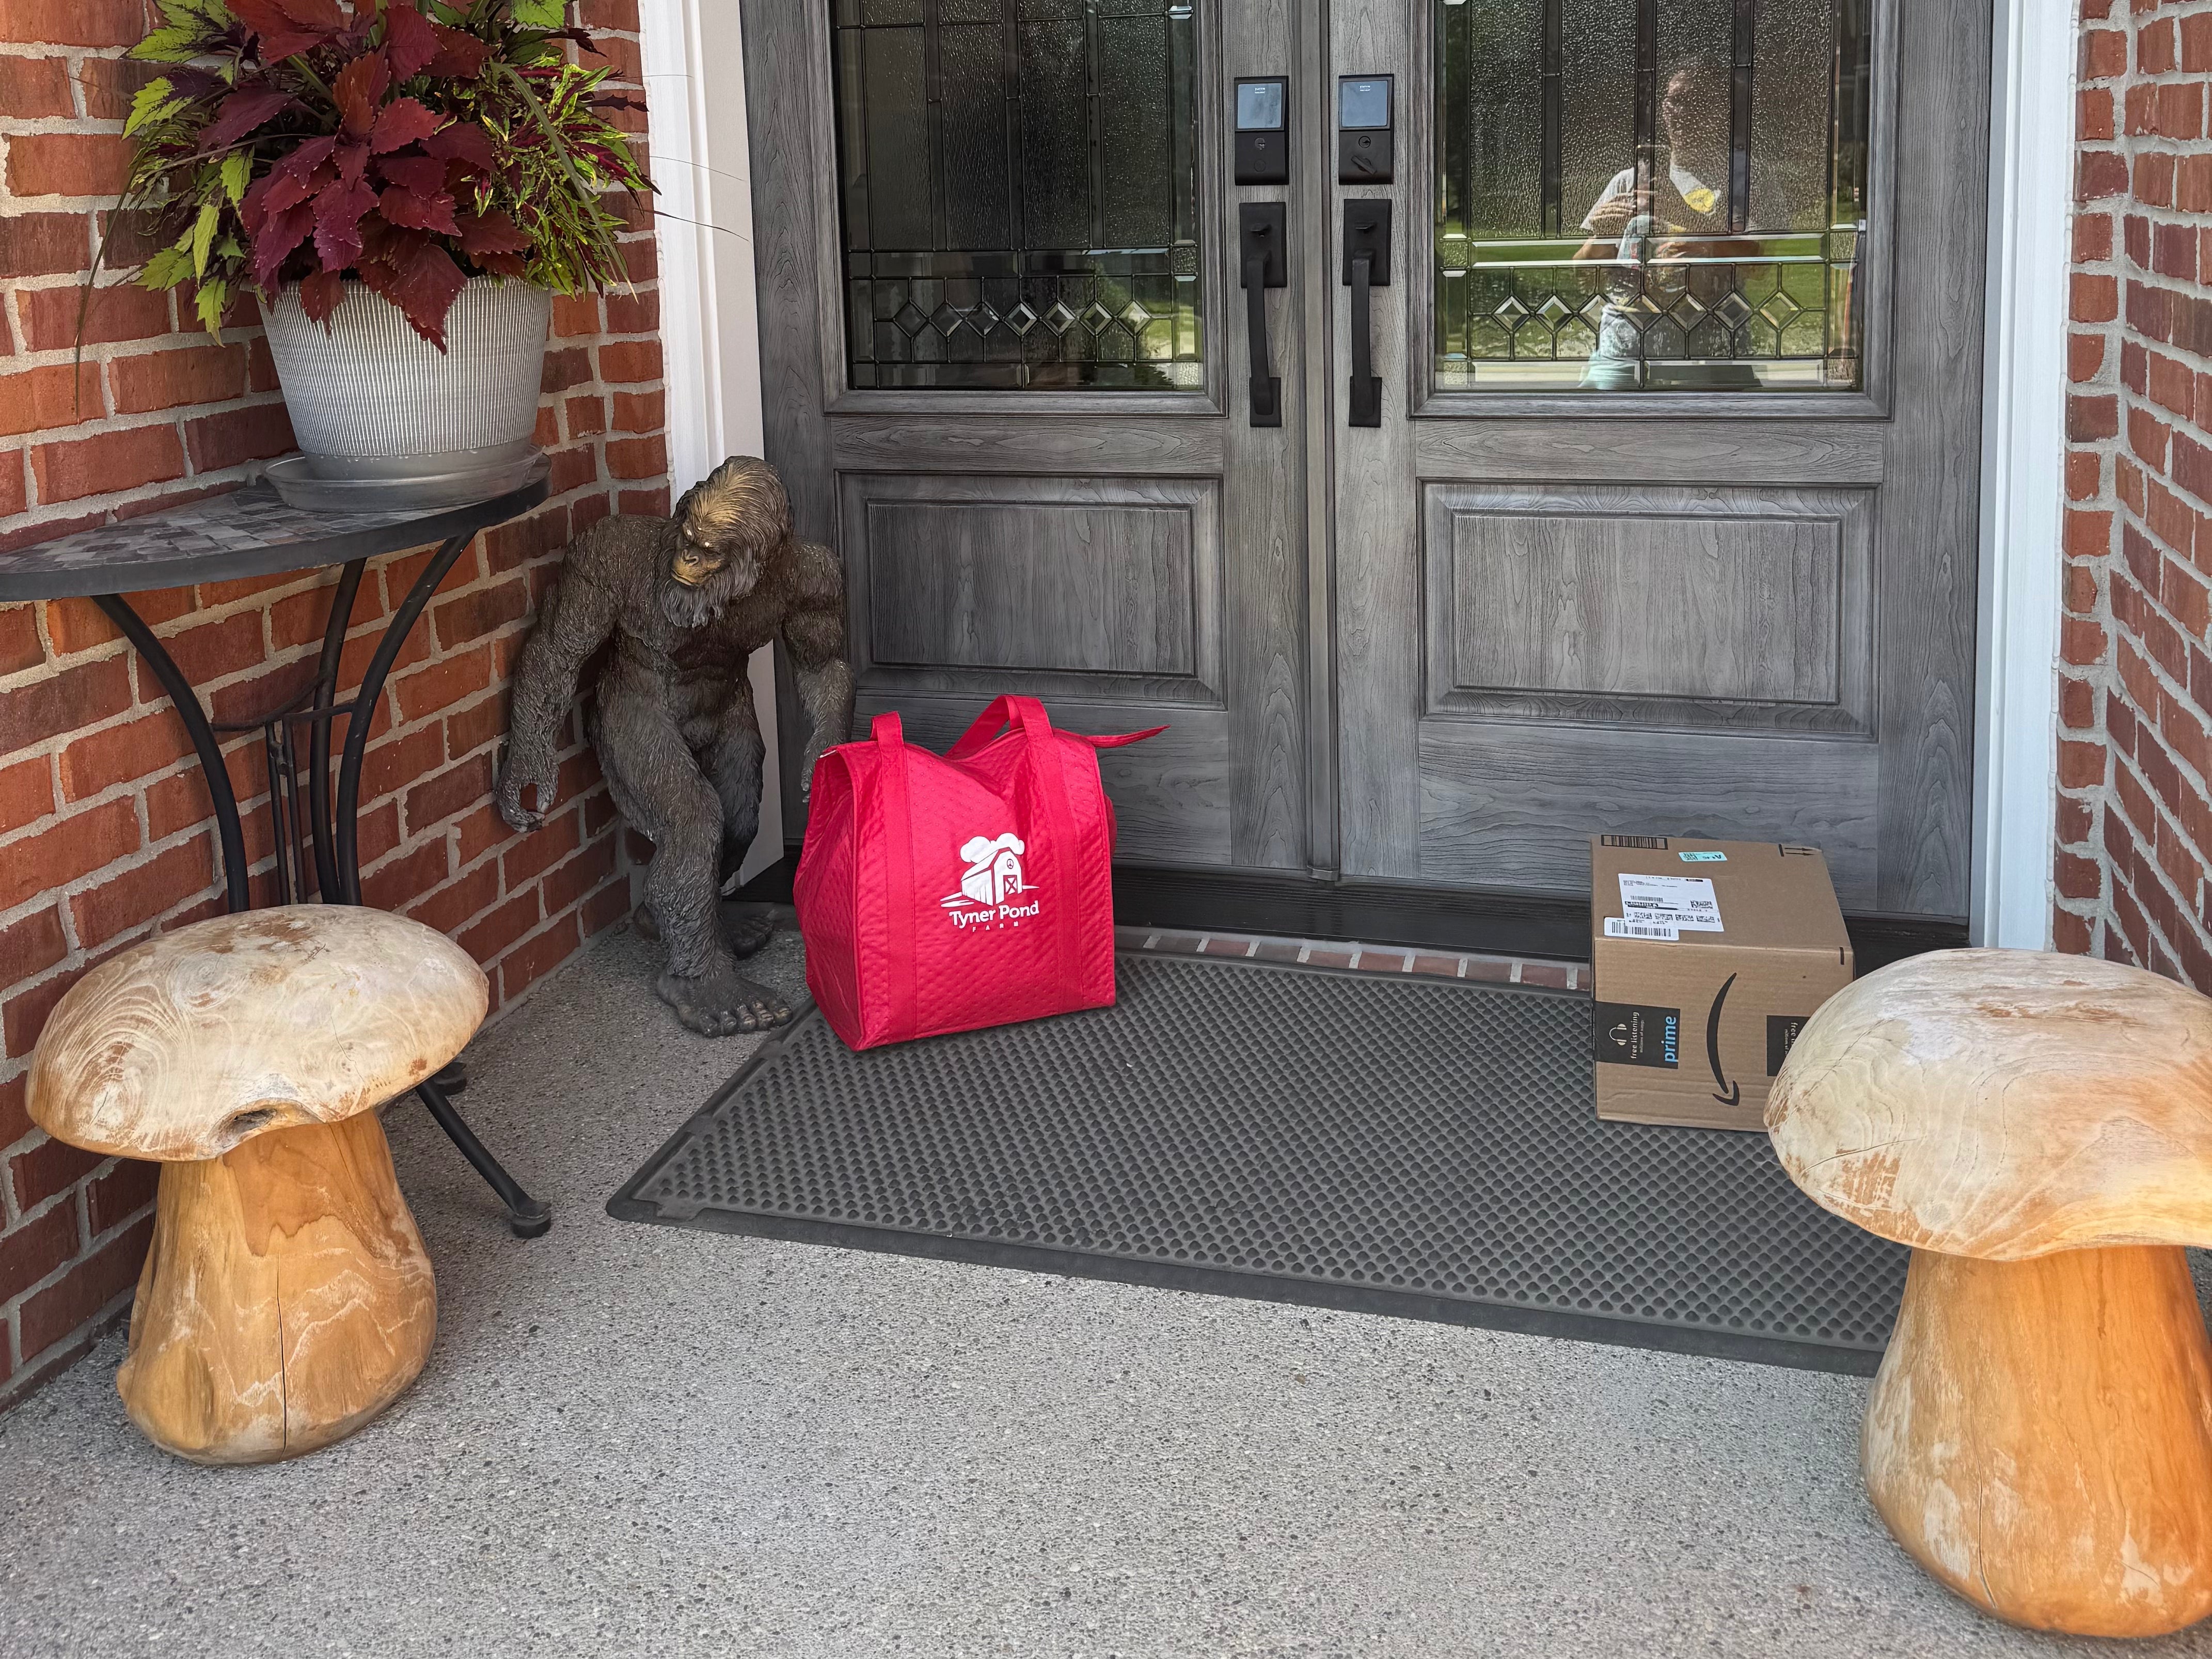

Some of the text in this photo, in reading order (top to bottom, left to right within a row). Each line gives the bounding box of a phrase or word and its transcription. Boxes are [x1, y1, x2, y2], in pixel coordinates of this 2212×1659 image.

[949, 900, 1040, 929] Tyner Pond
[972, 921, 1019, 933] FARM
[1631, 1012, 1639, 1043] listening
[1661, 1016, 1679, 1063] prime
